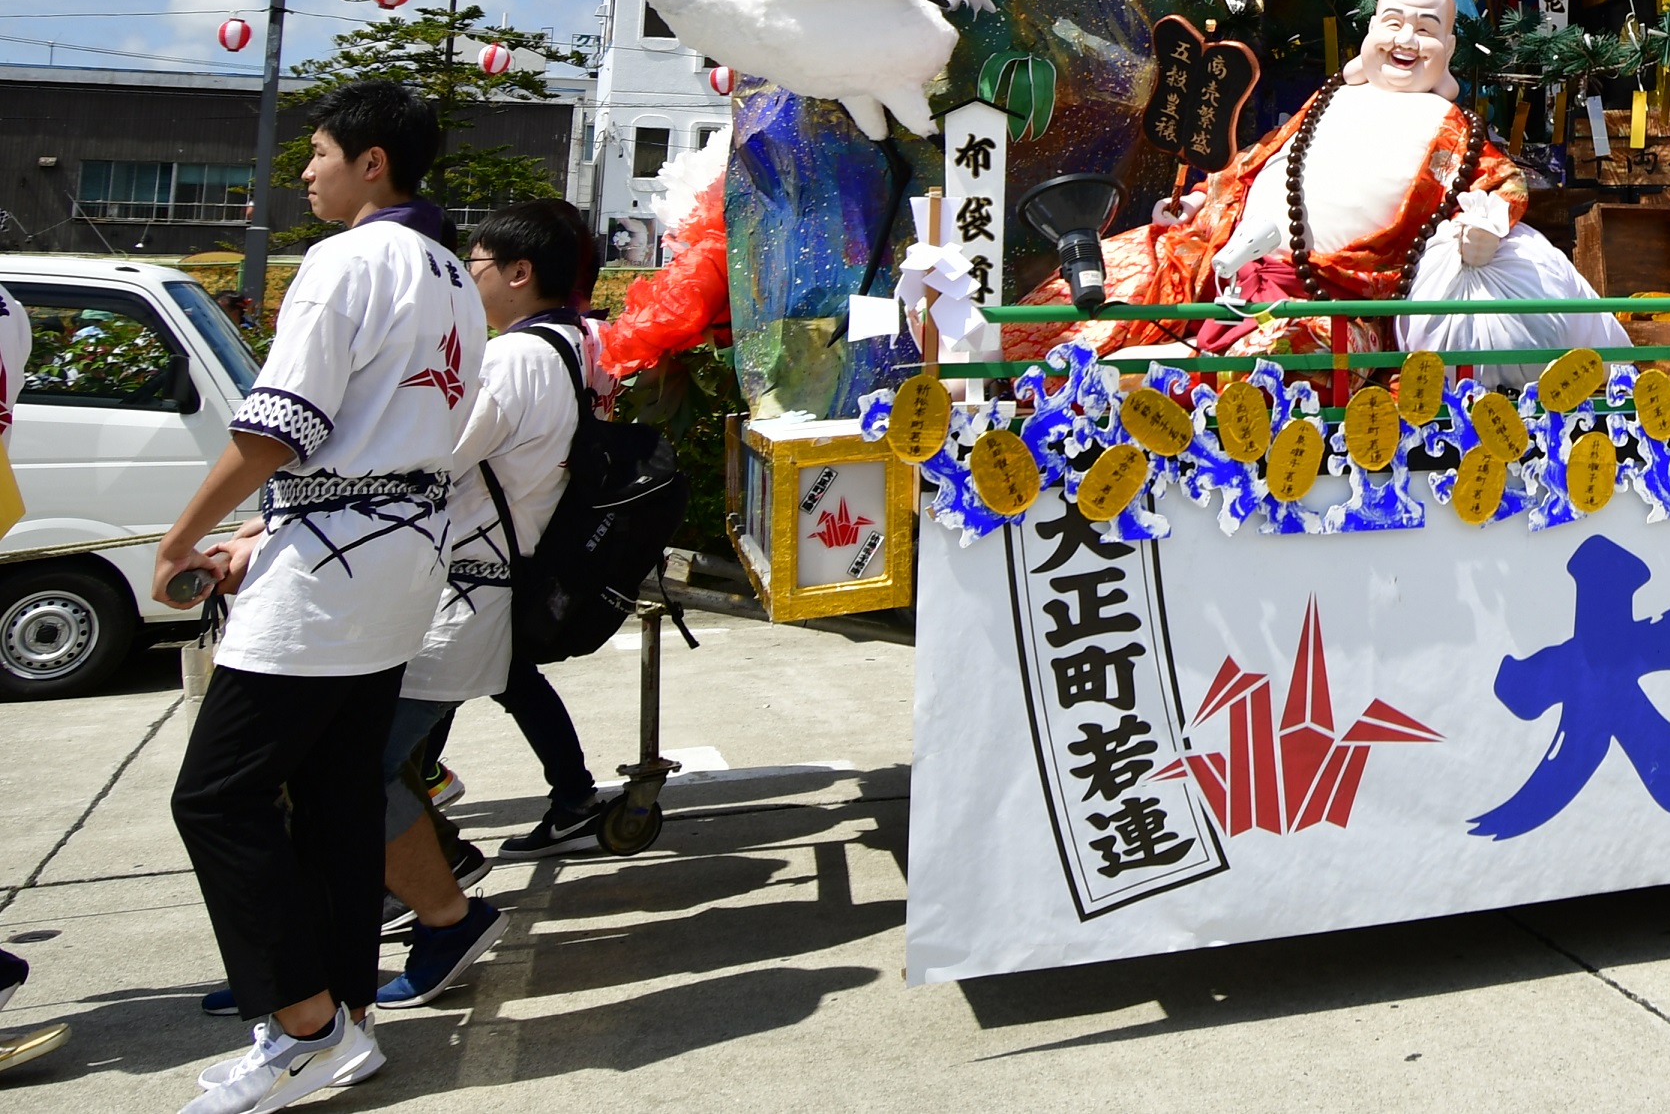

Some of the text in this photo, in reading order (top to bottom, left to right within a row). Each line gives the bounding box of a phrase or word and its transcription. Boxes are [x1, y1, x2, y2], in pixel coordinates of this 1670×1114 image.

[1190, 54, 1228, 156] 商売繁盛
[1029, 489, 1197, 879] 大正町若連
